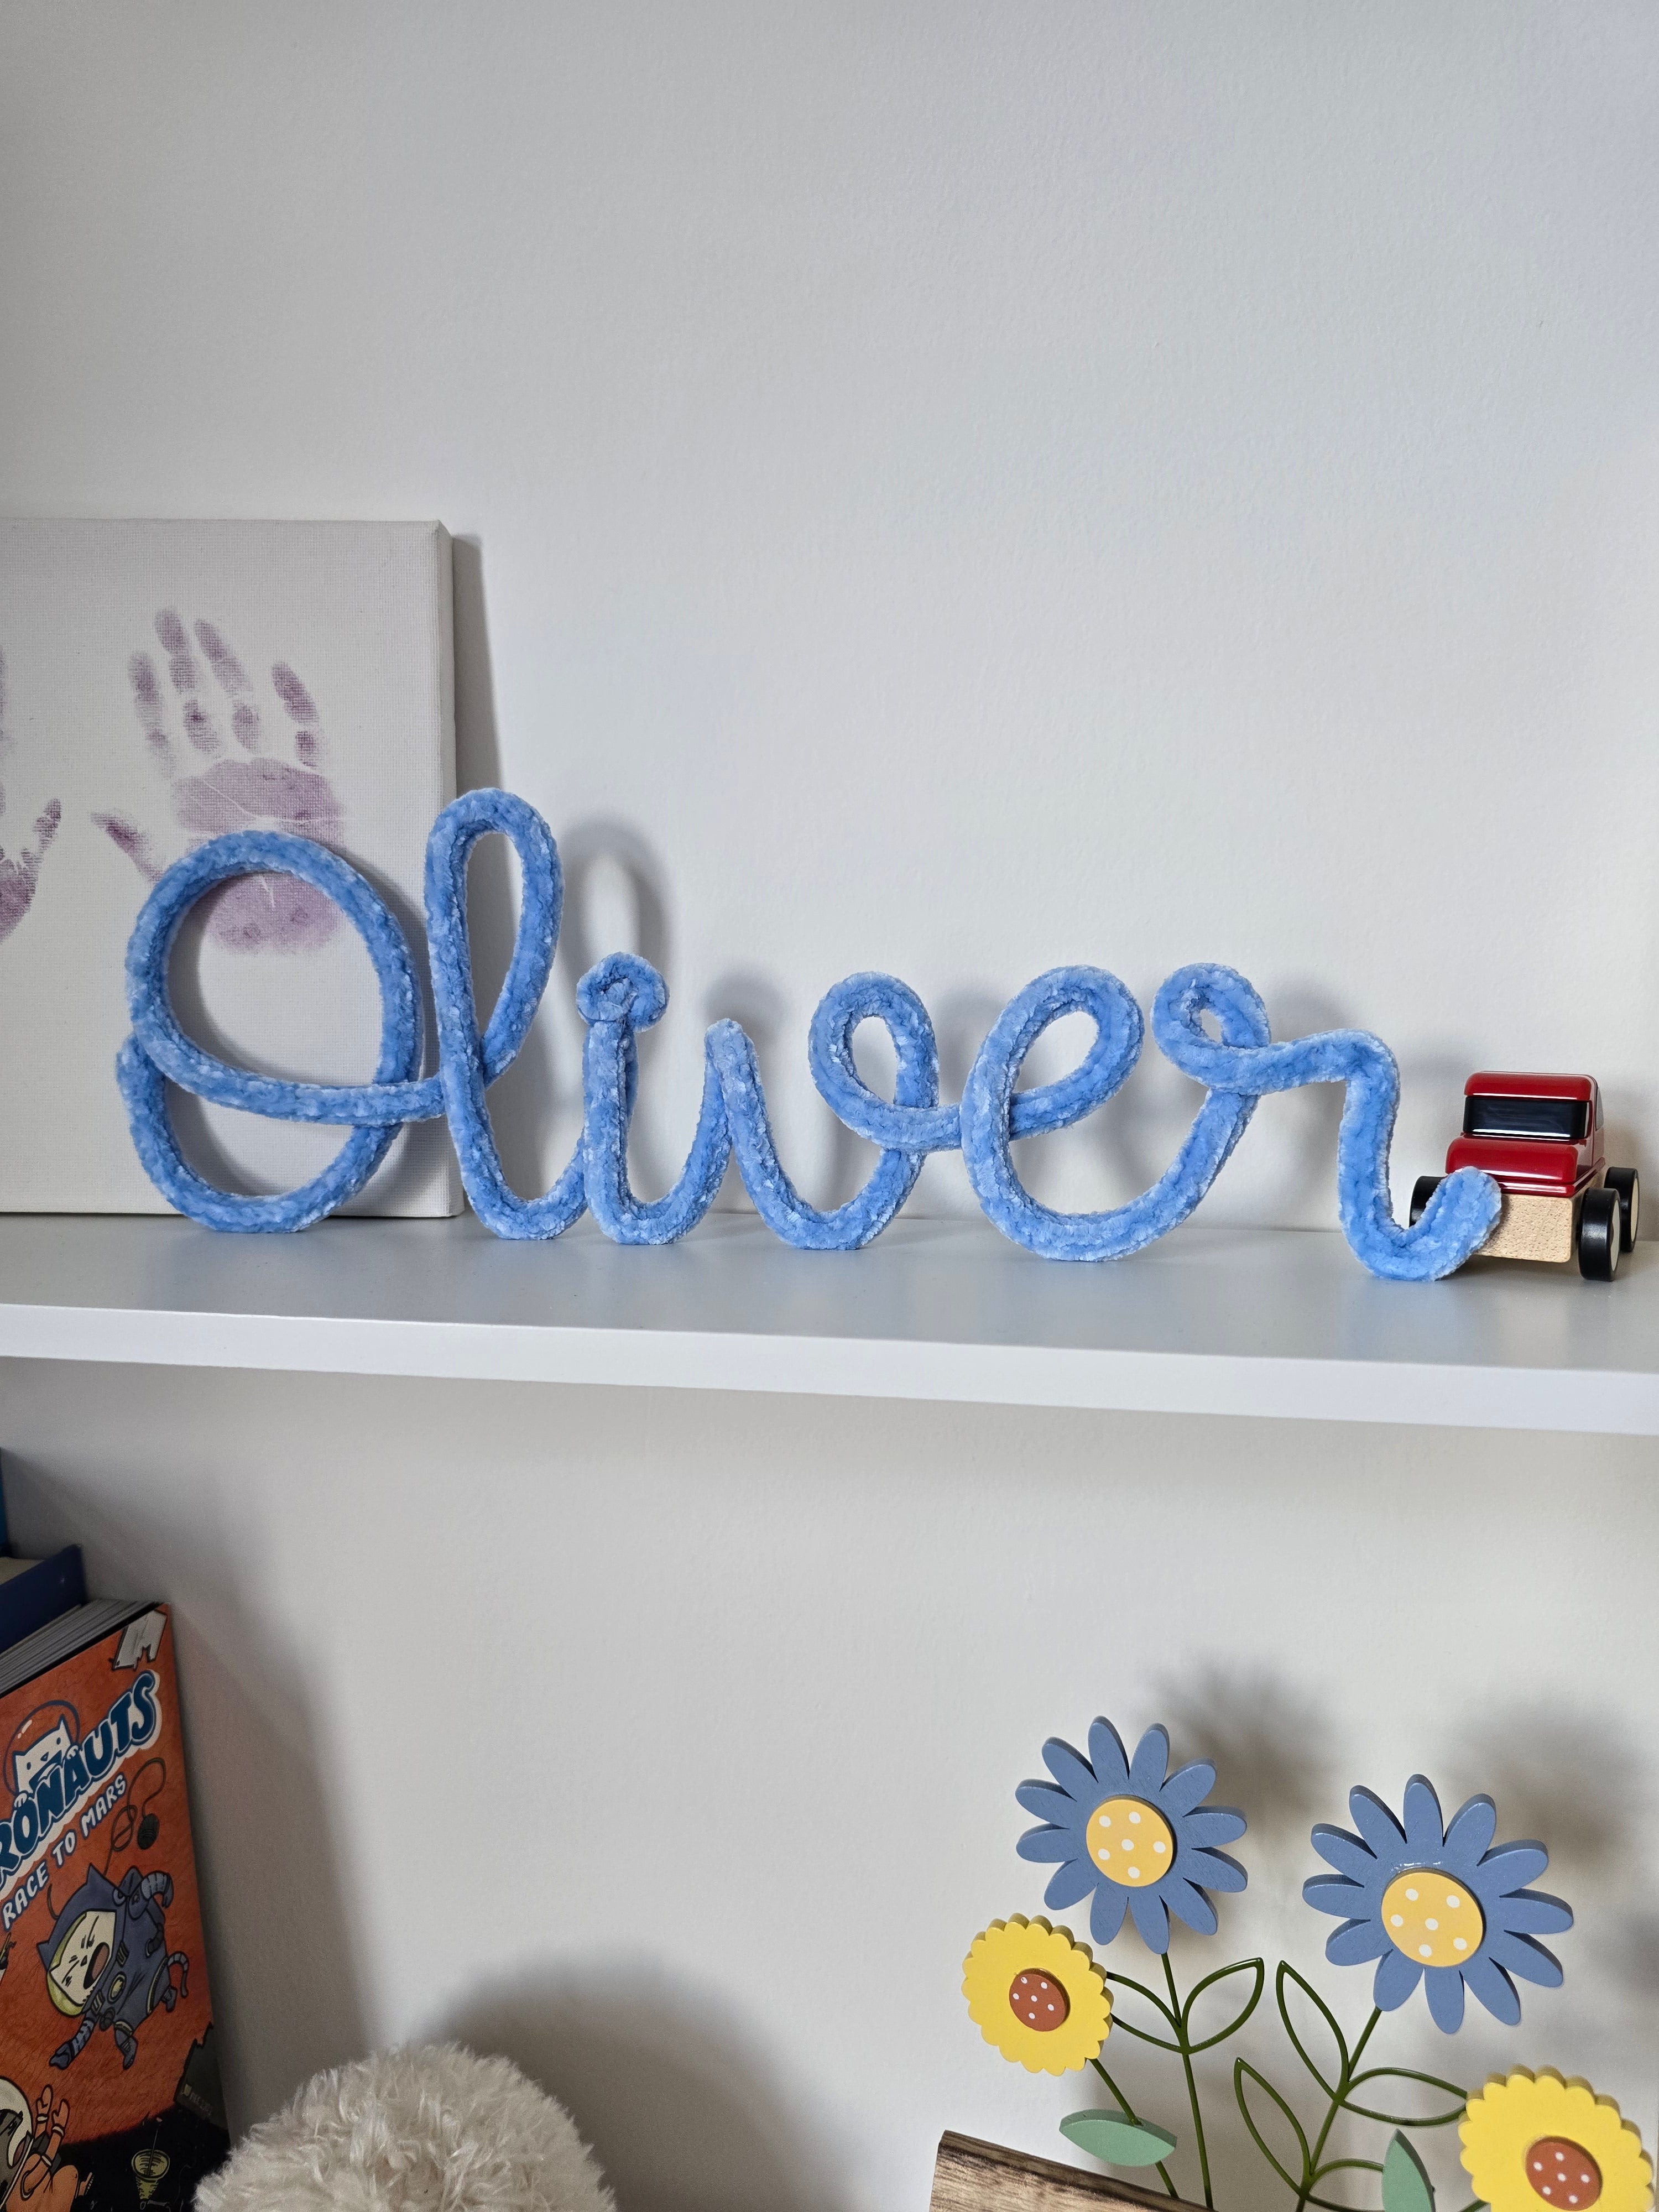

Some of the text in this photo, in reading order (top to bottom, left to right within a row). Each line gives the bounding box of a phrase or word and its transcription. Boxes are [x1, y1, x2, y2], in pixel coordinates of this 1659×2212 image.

[115, 787, 1503, 1283] Oliver
[2, 1773, 127, 1930] RACE TO MARS
